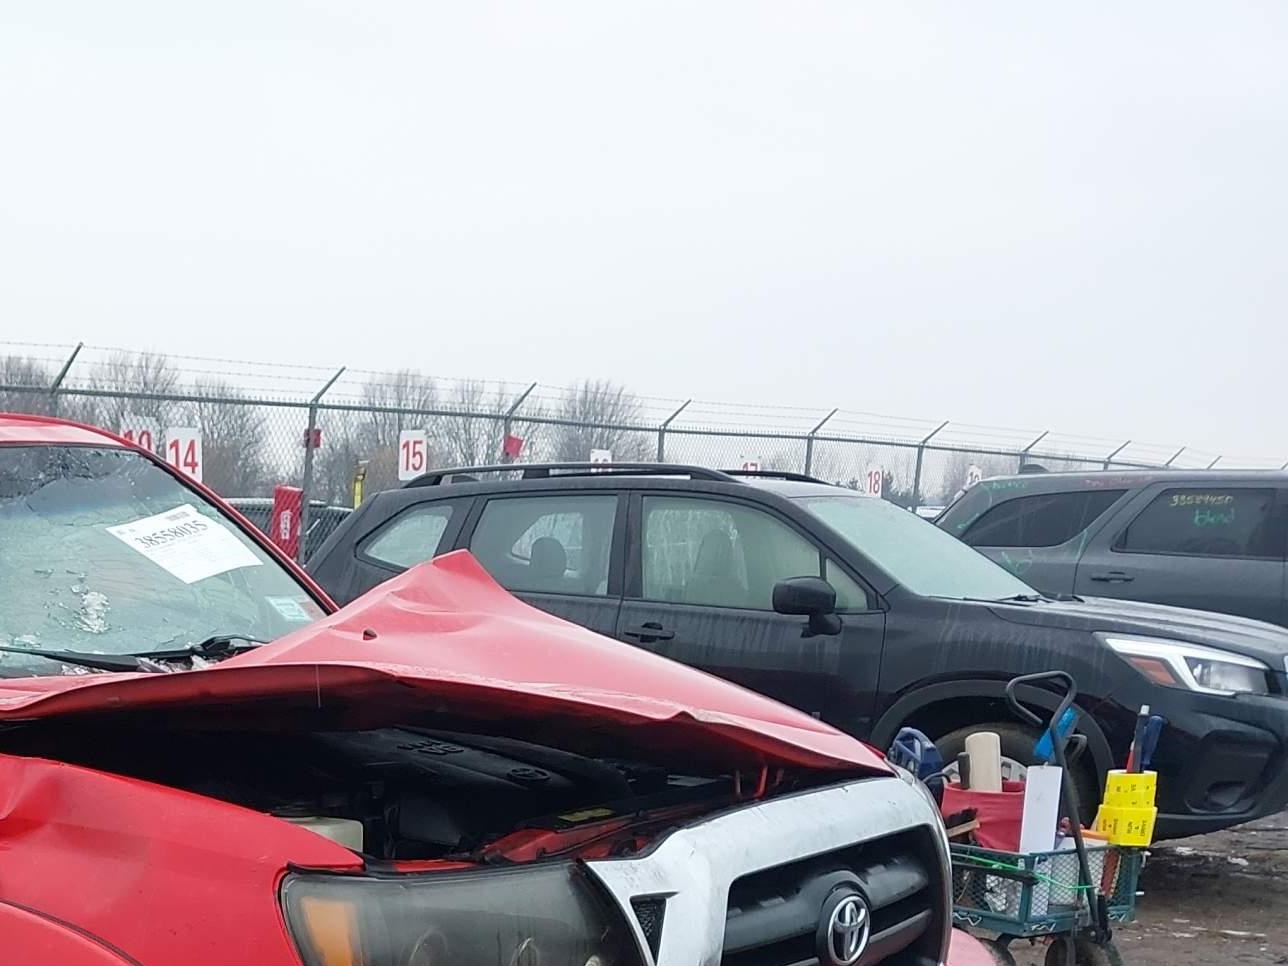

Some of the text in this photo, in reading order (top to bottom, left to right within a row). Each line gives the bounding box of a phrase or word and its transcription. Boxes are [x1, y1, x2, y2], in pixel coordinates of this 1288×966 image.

[169, 438, 198, 475] 14
[402, 440, 424, 472] 15
[867, 470, 881, 494] 18
[135, 520, 209, 549] 38558035
